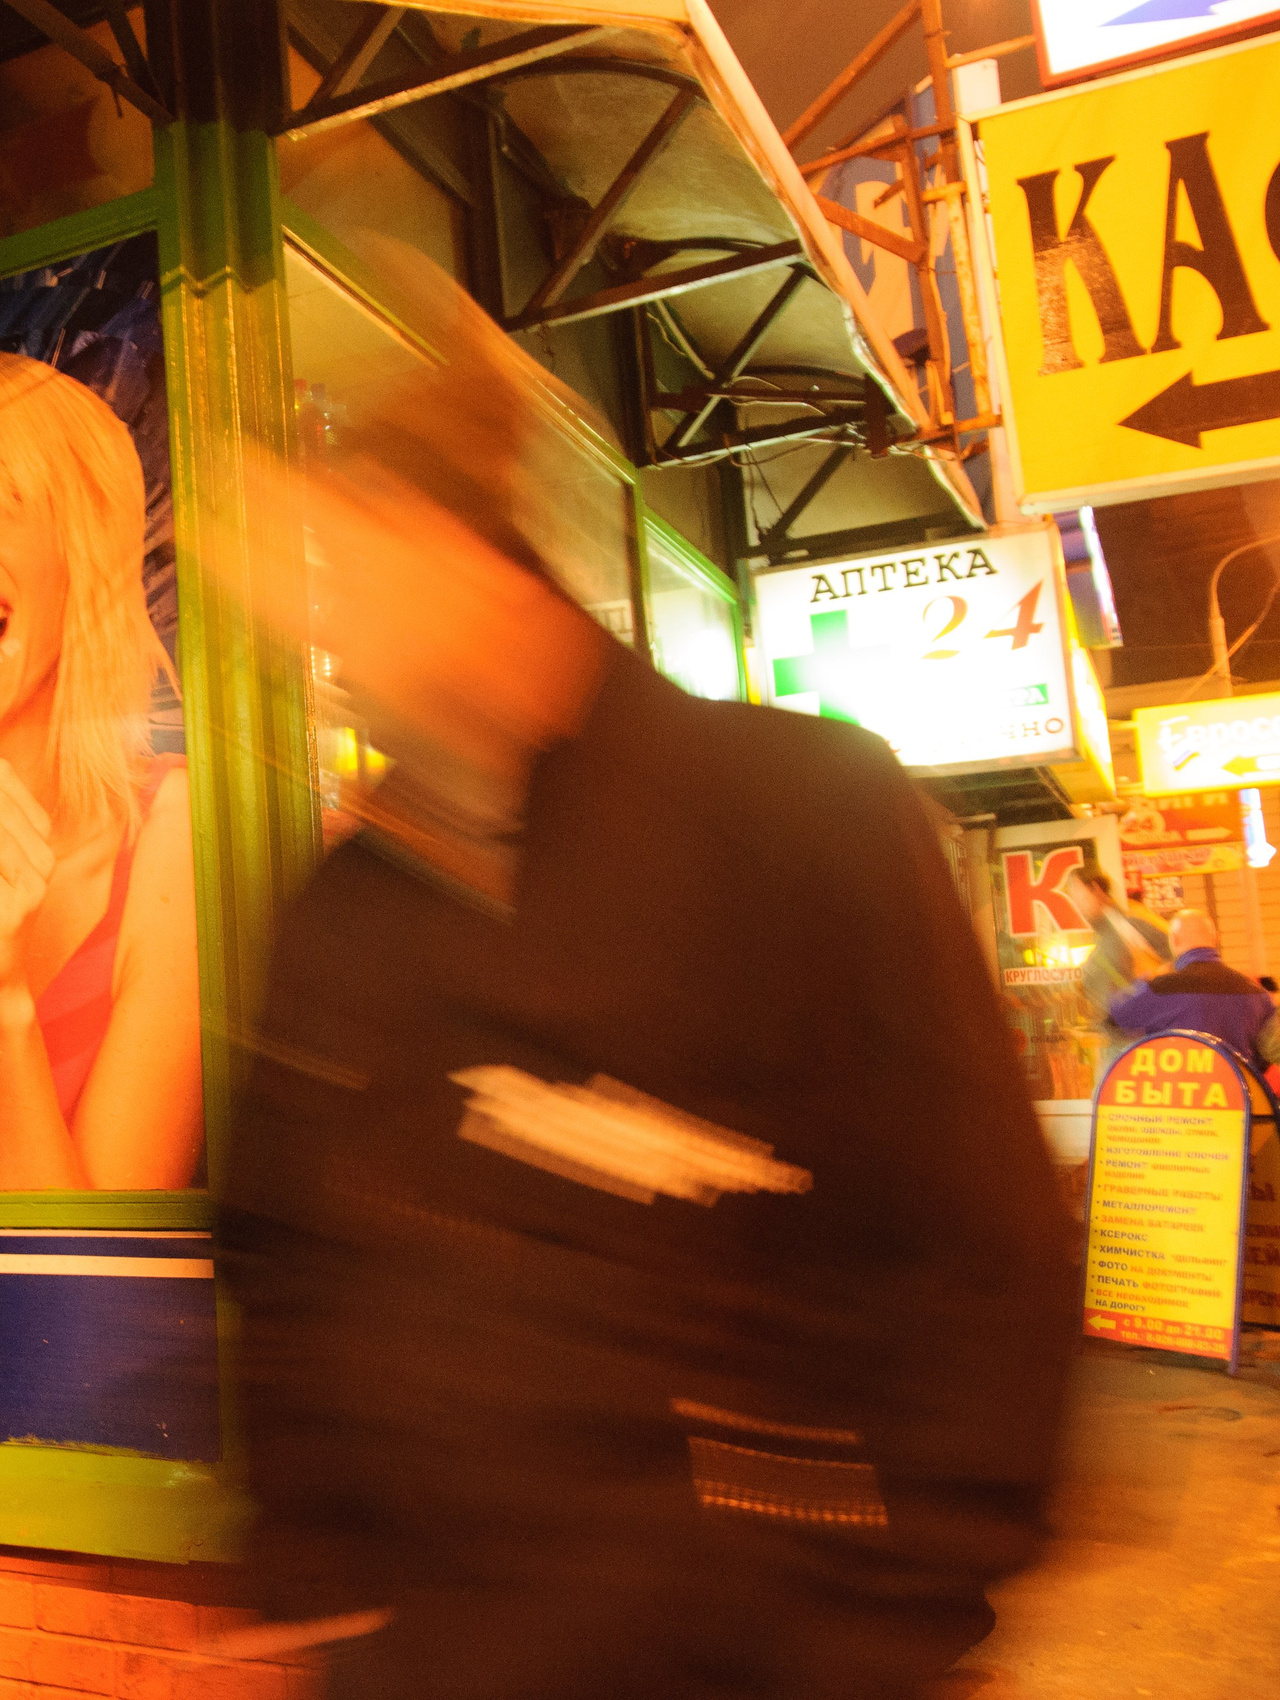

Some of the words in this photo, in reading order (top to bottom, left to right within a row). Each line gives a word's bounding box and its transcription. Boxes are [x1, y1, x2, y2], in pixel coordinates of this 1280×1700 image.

[1016, 131, 1280, 378] КА
[809, 547, 999, 603] АПТЕКА
[921, 578, 1046, 660] 24
[1129, 1047, 1215, 1077] ДОМ
[1114, 1079, 1229, 1107] БЫТА
[1105, 1158, 1148, 1169] РЕМОНТ
[1102, 1199, 1197, 1216] МЕТАЛЛОРЕМОНТ
[1101, 1214, 1144, 1227] ЗАМЕНА
[1100, 1228, 1148, 1242] КСЕРОКС
[1099, 1244, 1165, 1260] ХИМЧИСТКА
[1097, 1259, 1128, 1271] ФОТО
[1130, 1264, 1143, 1273] НА
[1096, 1274, 1139, 1288] ПЕЧАТЬ
[1095, 1287, 1113, 1297] ВСЕ
[1095, 1298, 1107, 1307] НА
[1109, 1300, 1145, 1314] ДОРОГУ
[1133, 1316, 1163, 1332] 9.00
